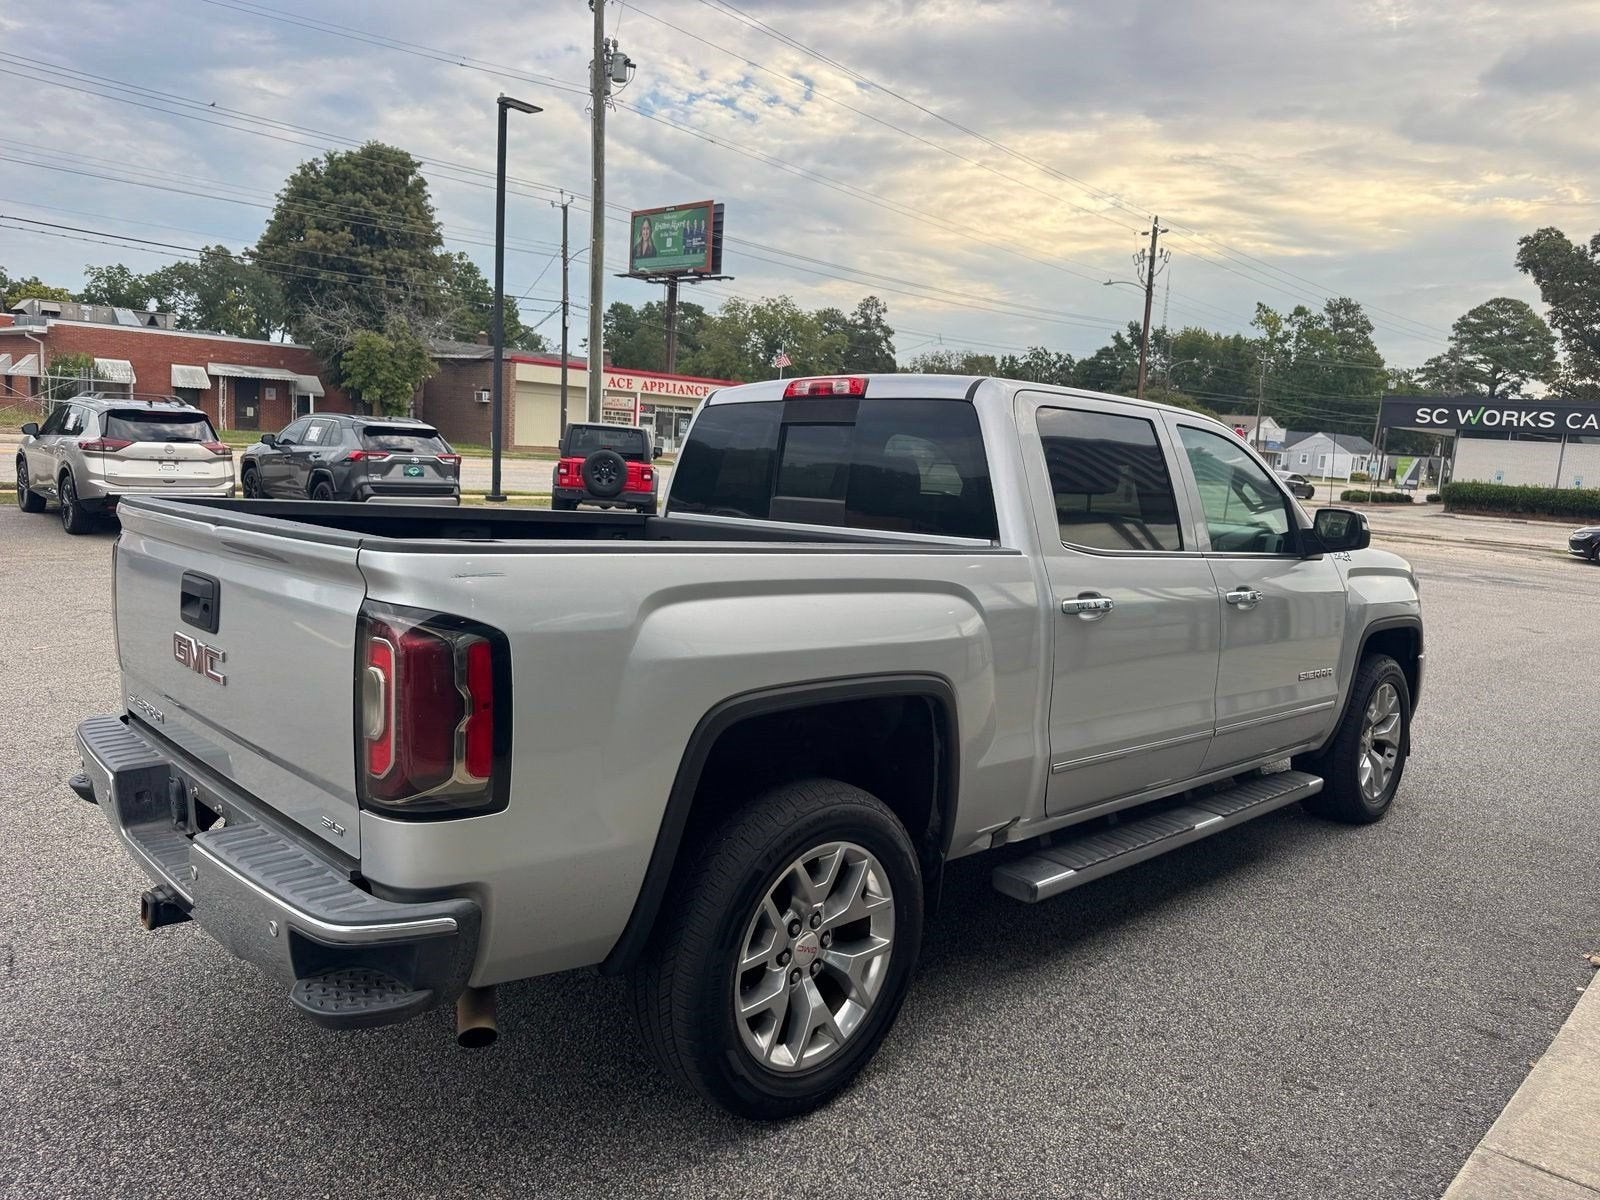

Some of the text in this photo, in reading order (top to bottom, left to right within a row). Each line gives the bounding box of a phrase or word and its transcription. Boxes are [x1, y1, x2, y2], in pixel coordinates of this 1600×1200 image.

[608, 377, 710, 396] ACE APPLIANCE
[1415, 406, 1600, 430] SC WORKS CA
[173, 631, 226, 686] GMC
[1298, 668, 1333, 681] SIERRA
